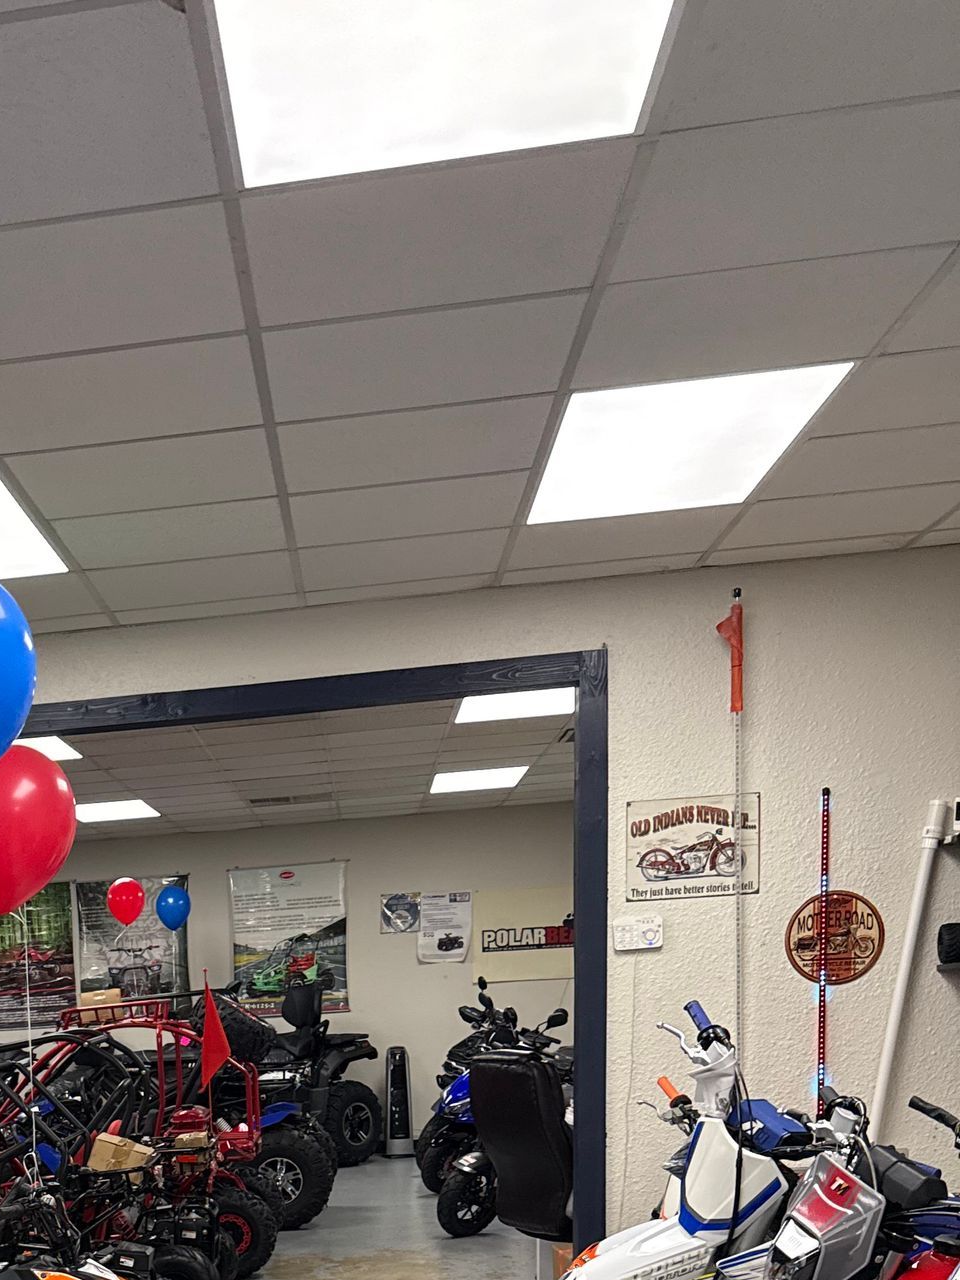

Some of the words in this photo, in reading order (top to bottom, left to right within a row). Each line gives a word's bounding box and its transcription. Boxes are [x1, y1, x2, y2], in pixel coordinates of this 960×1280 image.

[630, 818, 651, 838] OLD
[652, 805, 695, 833] INDIANS
[696, 805, 729, 827] NEVER
[631, 888, 648, 898] They
[649, 886, 664, 898] just
[665, 883, 682, 896] have
[683, 885, 705, 895] better
[706, 882, 731, 893] stories
[797, 910, 842, 934] MOTER
[844, 910, 874, 930] ROAD
